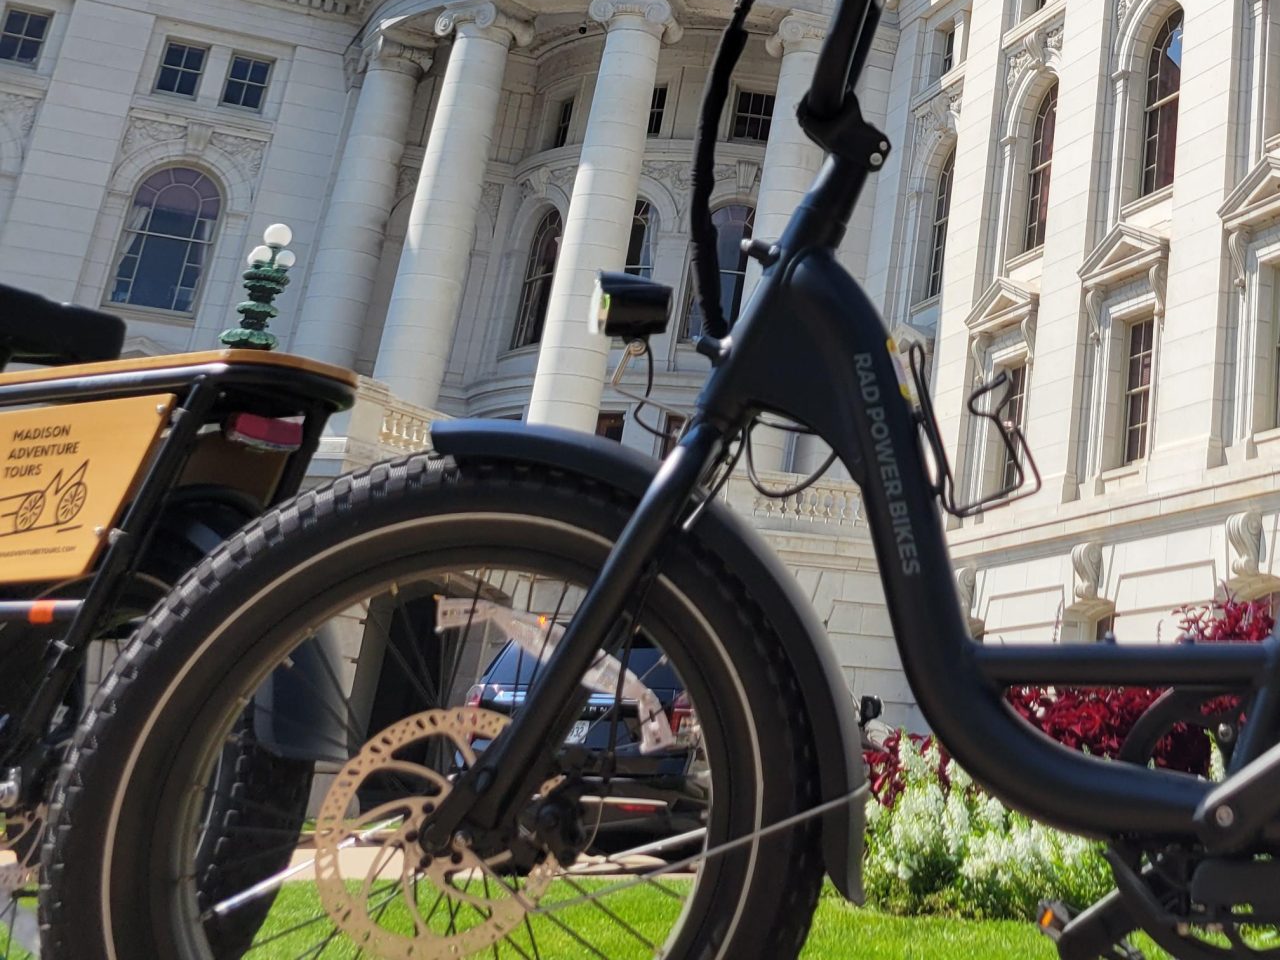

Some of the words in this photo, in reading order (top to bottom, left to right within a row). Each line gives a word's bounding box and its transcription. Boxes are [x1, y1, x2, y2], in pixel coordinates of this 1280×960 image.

[854, 352, 880, 402] RAD
[13, 424, 71, 440] MADISON
[7, 442, 79, 460] ADVENTURE
[866, 406, 903, 499] POWER
[4, 464, 42, 478] TOURS
[888, 501, 920, 576] BIKES
